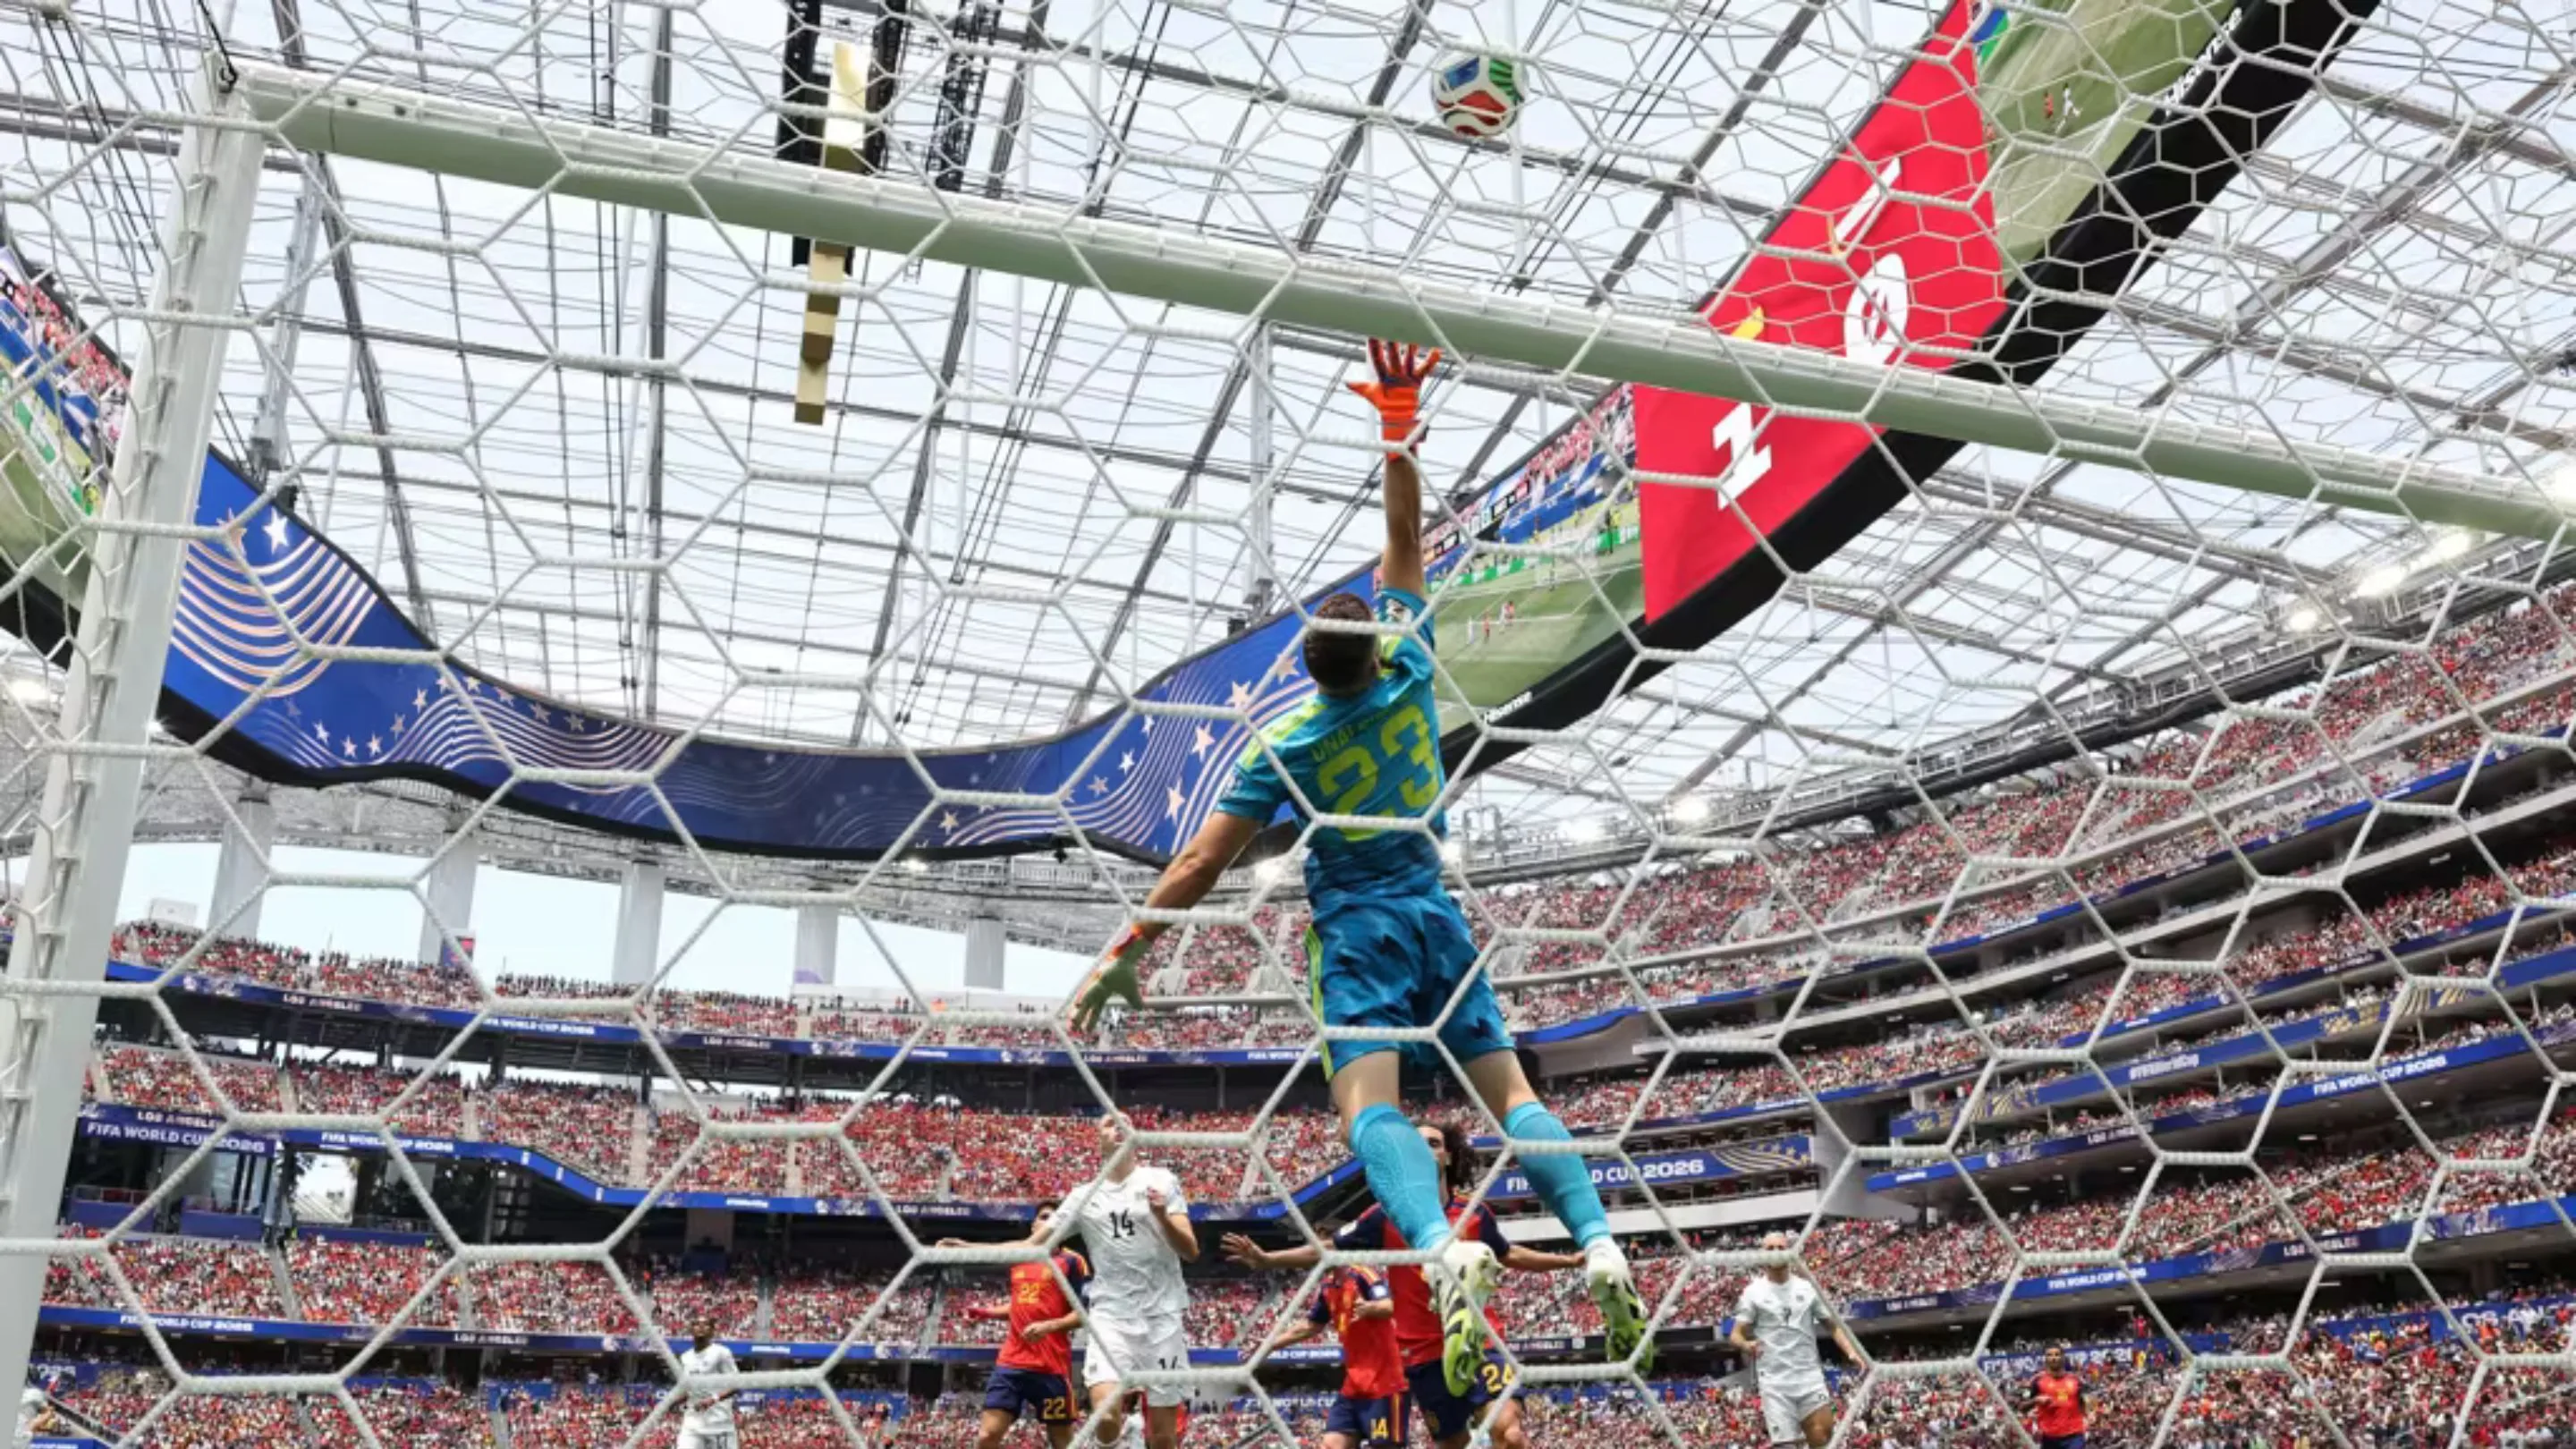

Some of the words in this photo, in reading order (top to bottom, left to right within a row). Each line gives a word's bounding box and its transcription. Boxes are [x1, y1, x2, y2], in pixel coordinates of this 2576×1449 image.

[1318, 704, 1440, 842] 23
[87, 1122, 121, 1138] FIFA
[123, 1126, 179, 1143] WORLD
[1606, 1165, 1636, 1182] CU
[1642, 1159, 1705, 1179] 2026
[1109, 1208, 1135, 1238] 14
[1017, 1283, 1040, 1303] 22
[1043, 1397, 1066, 1419] 22
